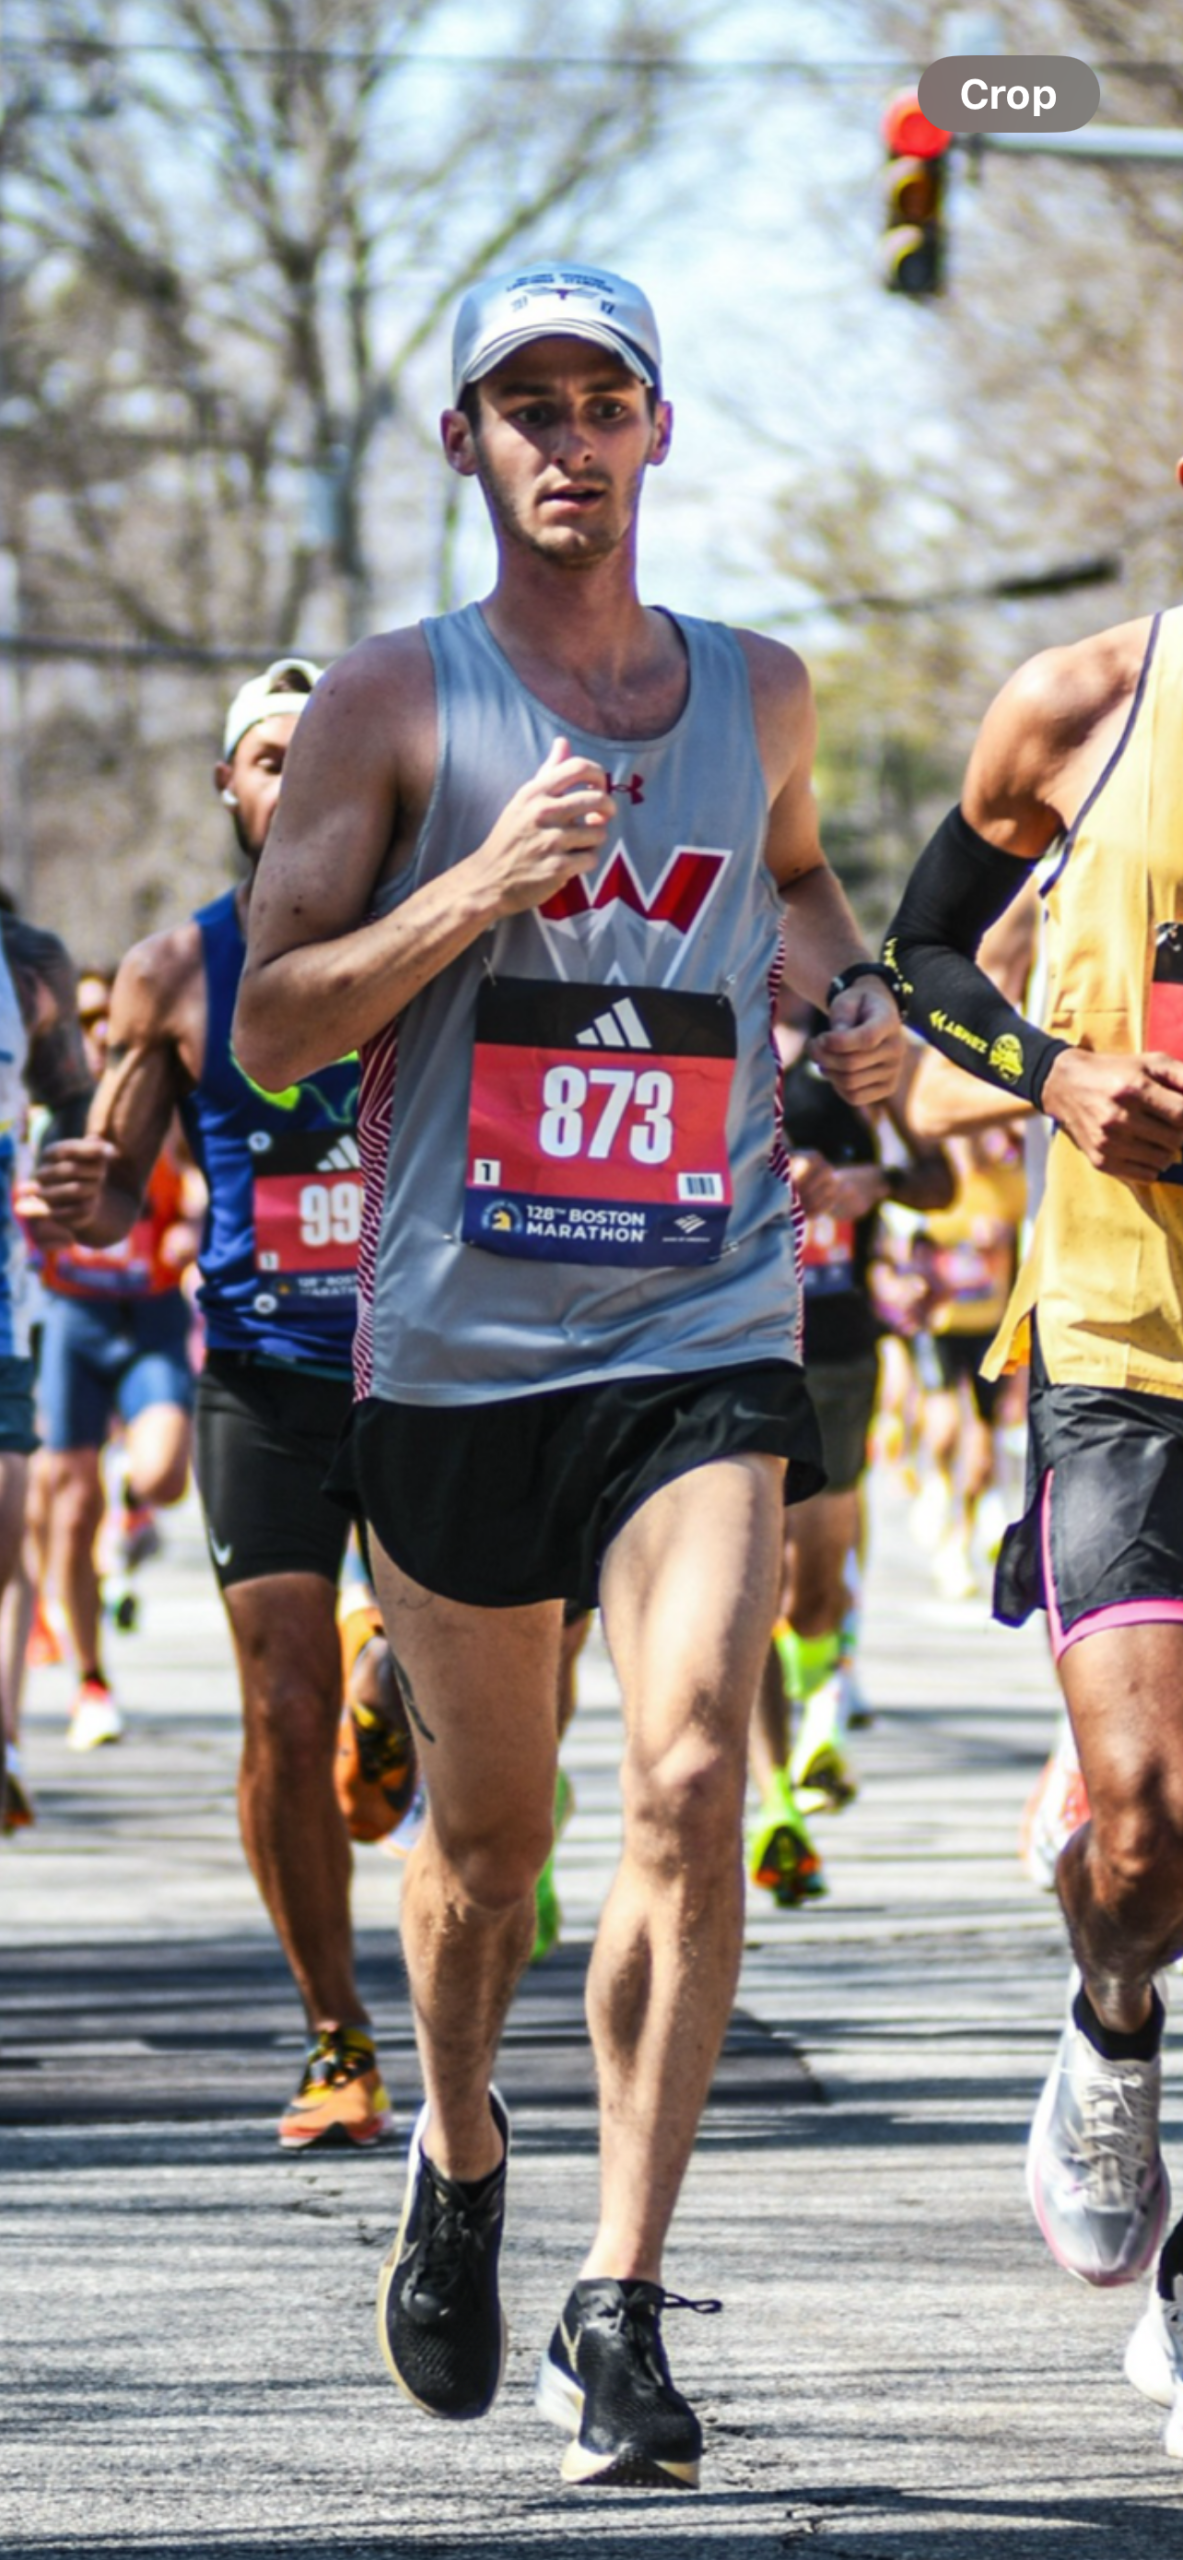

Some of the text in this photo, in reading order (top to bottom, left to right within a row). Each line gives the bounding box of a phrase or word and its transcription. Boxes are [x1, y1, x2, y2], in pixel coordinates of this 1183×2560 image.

[539, 1065, 674, 1165] 873
[481, 1162, 491, 1182] 1
[569, 1209, 646, 1227] BOSTON
[526, 1221, 646, 1243] MARATHON
